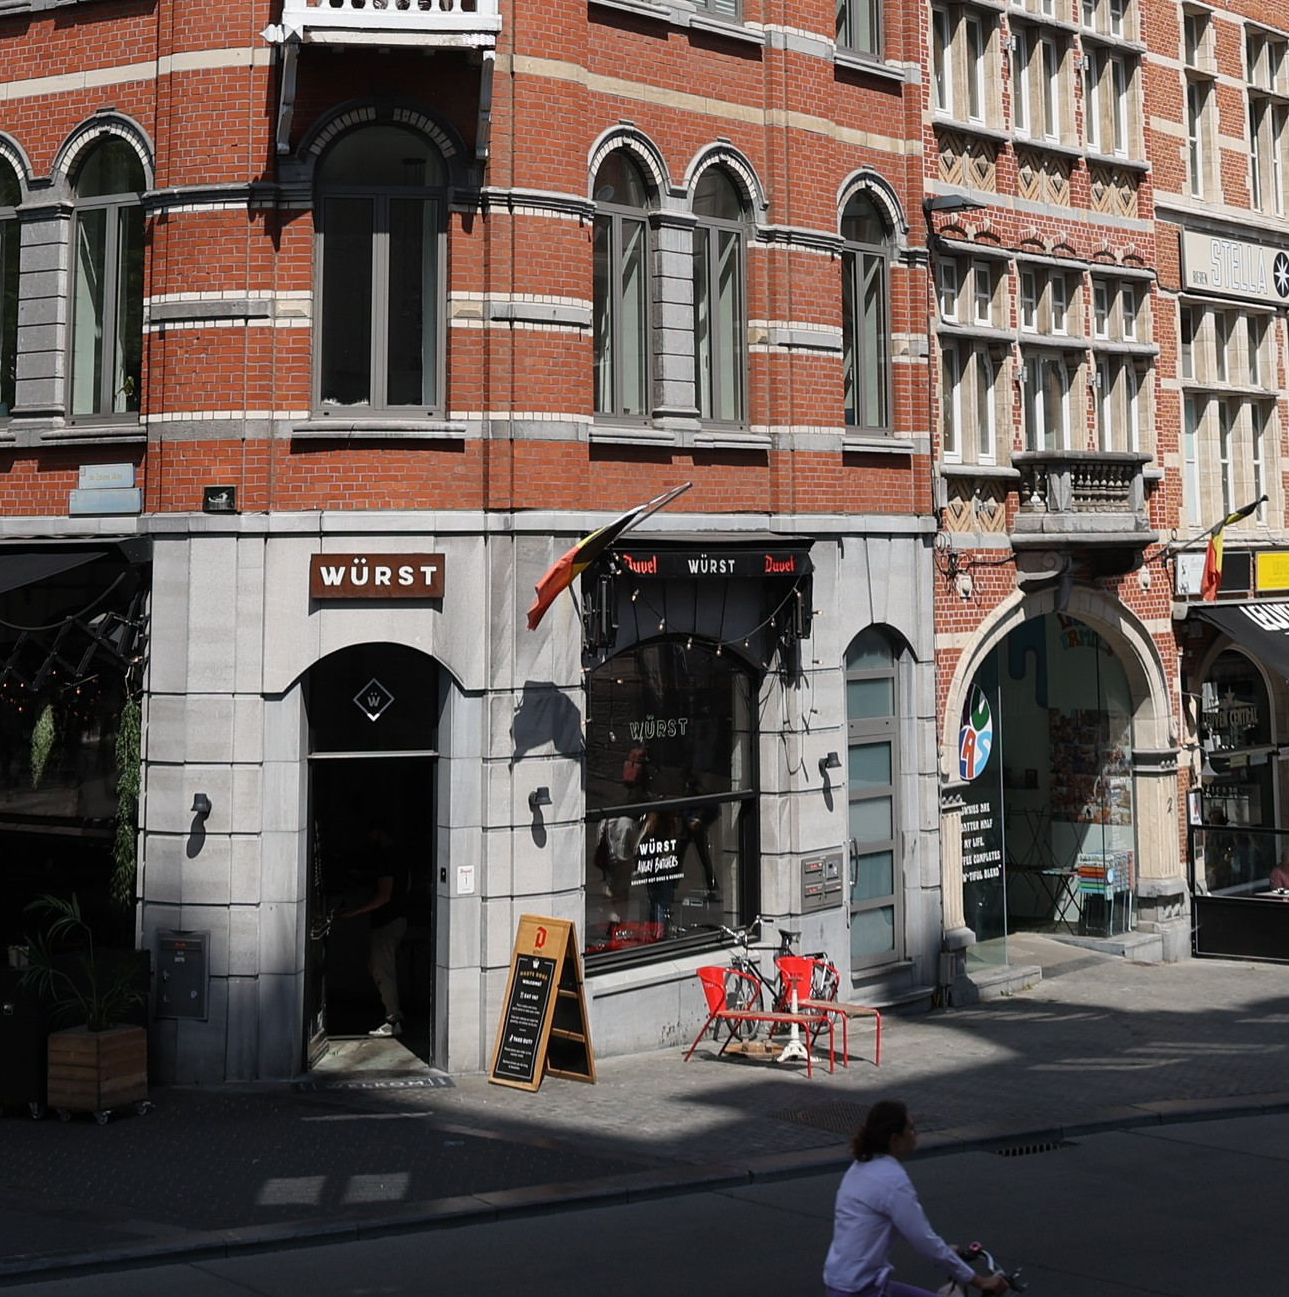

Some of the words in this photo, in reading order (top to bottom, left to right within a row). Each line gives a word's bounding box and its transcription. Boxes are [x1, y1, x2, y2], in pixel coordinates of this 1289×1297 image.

[1210, 237, 1268, 295] STELLA
[320, 559, 437, 587] WÜRST
[688, 557, 736, 574] WÜRST
[763, 555, 795, 573] Duvel
[629, 715, 689, 743] WÜRST
[640, 838, 677, 855] WÜRST
